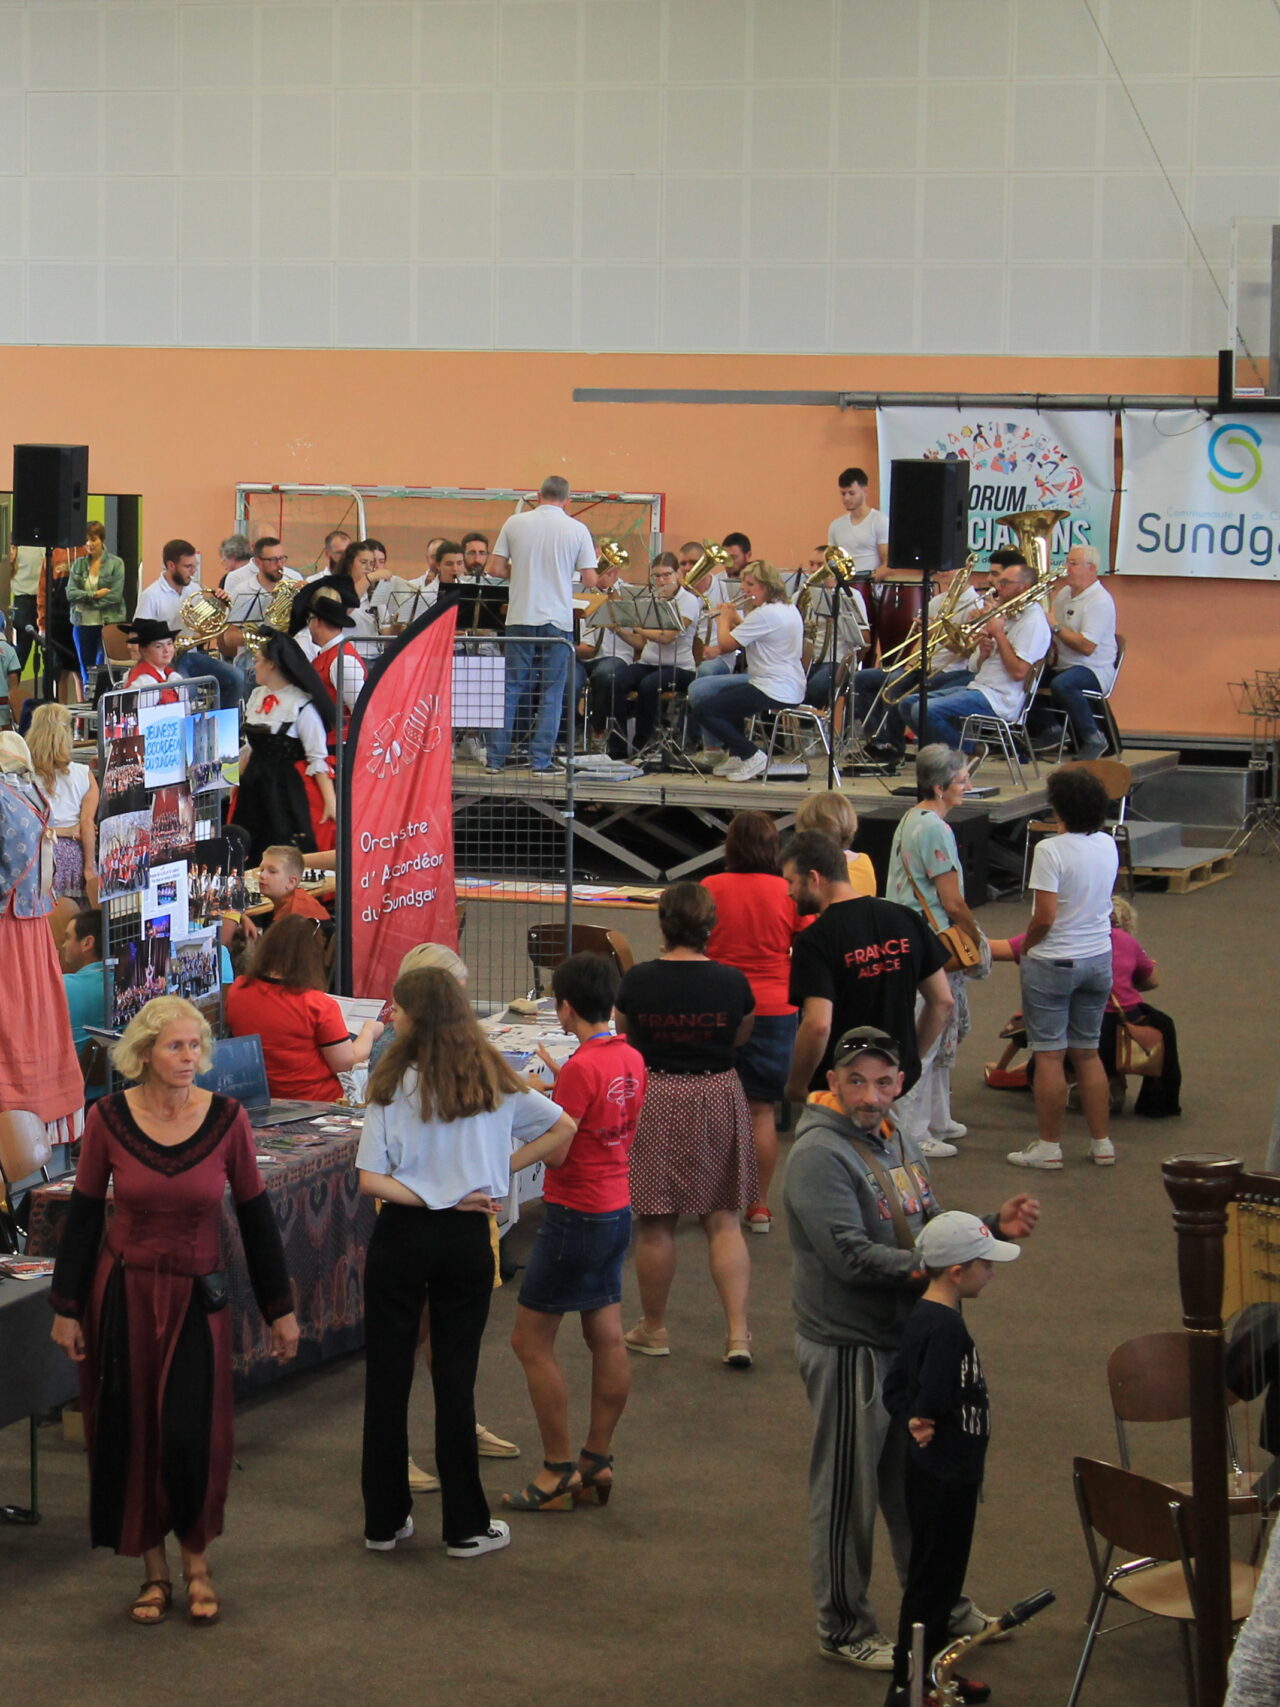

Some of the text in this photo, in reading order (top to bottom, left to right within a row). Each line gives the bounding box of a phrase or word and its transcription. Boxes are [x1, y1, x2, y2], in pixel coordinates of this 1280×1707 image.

[969, 484, 1027, 512] ORUM
[1136, 512, 1280, 567] Sundg
[844, 938, 910, 968] FRANCE
[858, 958, 901, 979] ALSACE
[638, 1011, 729, 1028] FRANCE
